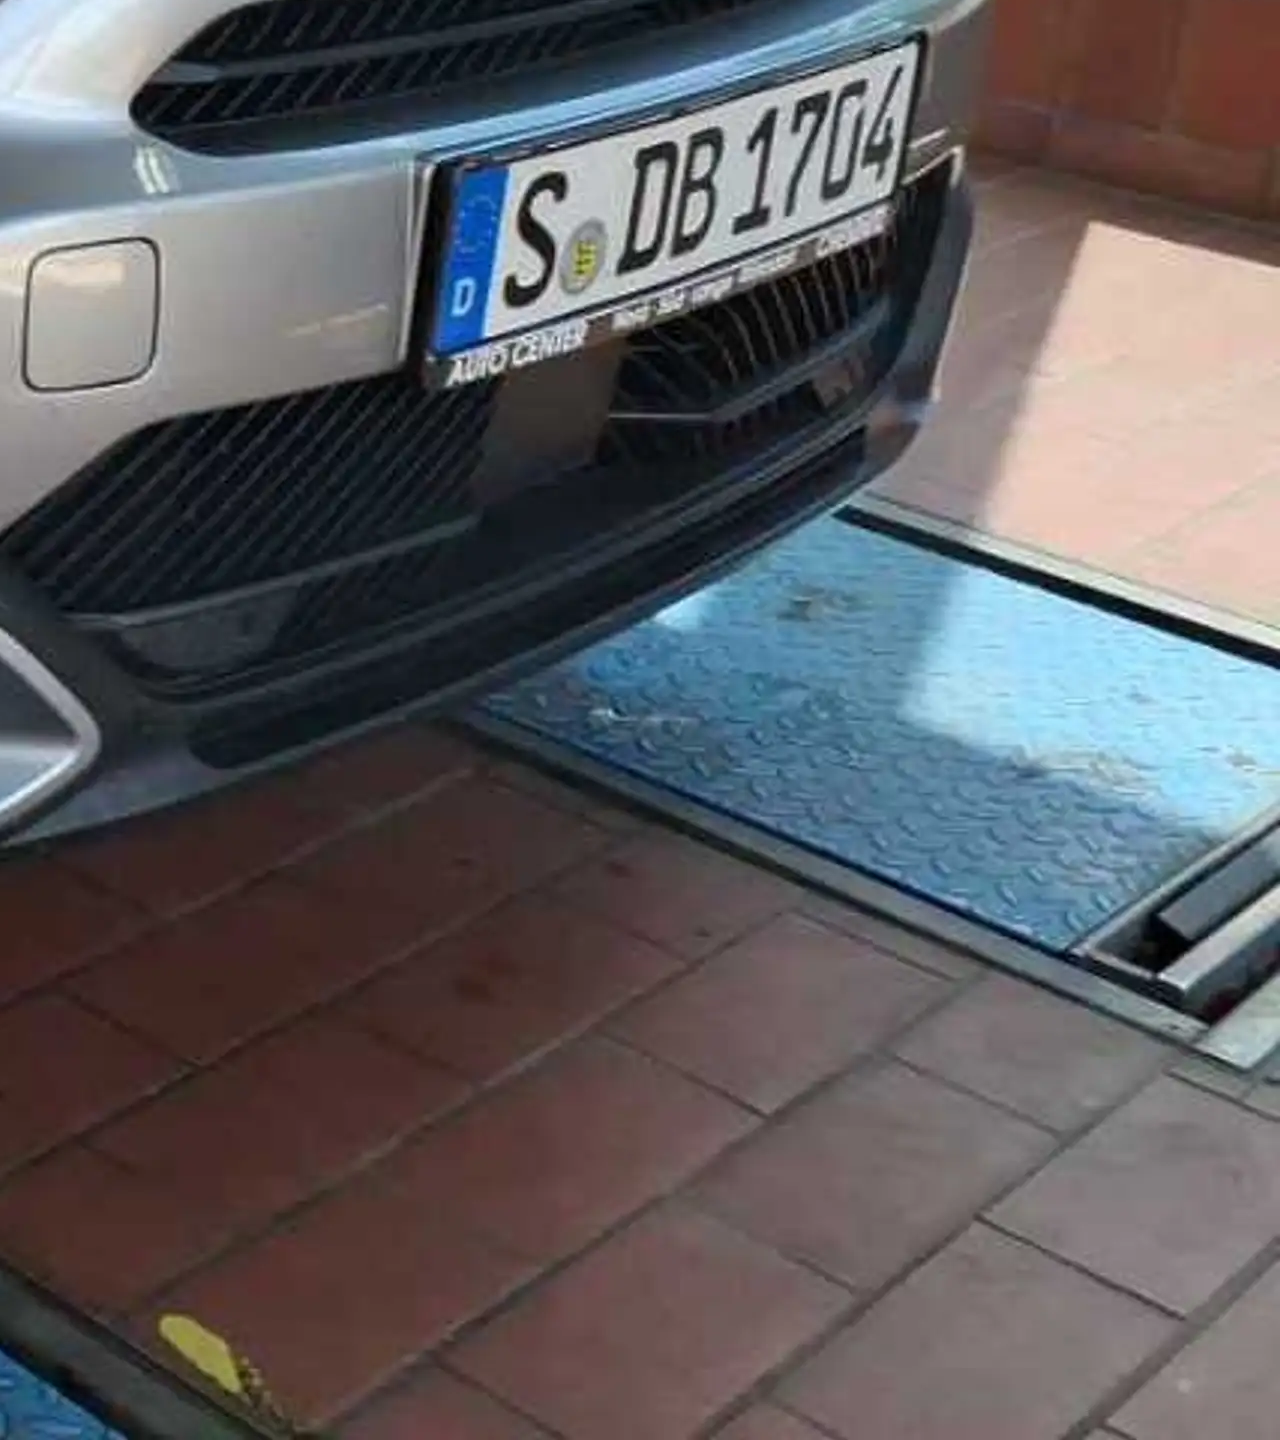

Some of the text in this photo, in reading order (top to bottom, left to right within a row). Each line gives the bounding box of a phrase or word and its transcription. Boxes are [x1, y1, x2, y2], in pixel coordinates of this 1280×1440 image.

[504, 171, 567, 307] S
[616, 126, 724, 276] DB
[733, 65, 904, 235] 1704
[451, 278, 476, 316] D
[446, 348, 508, 387] AUTO
